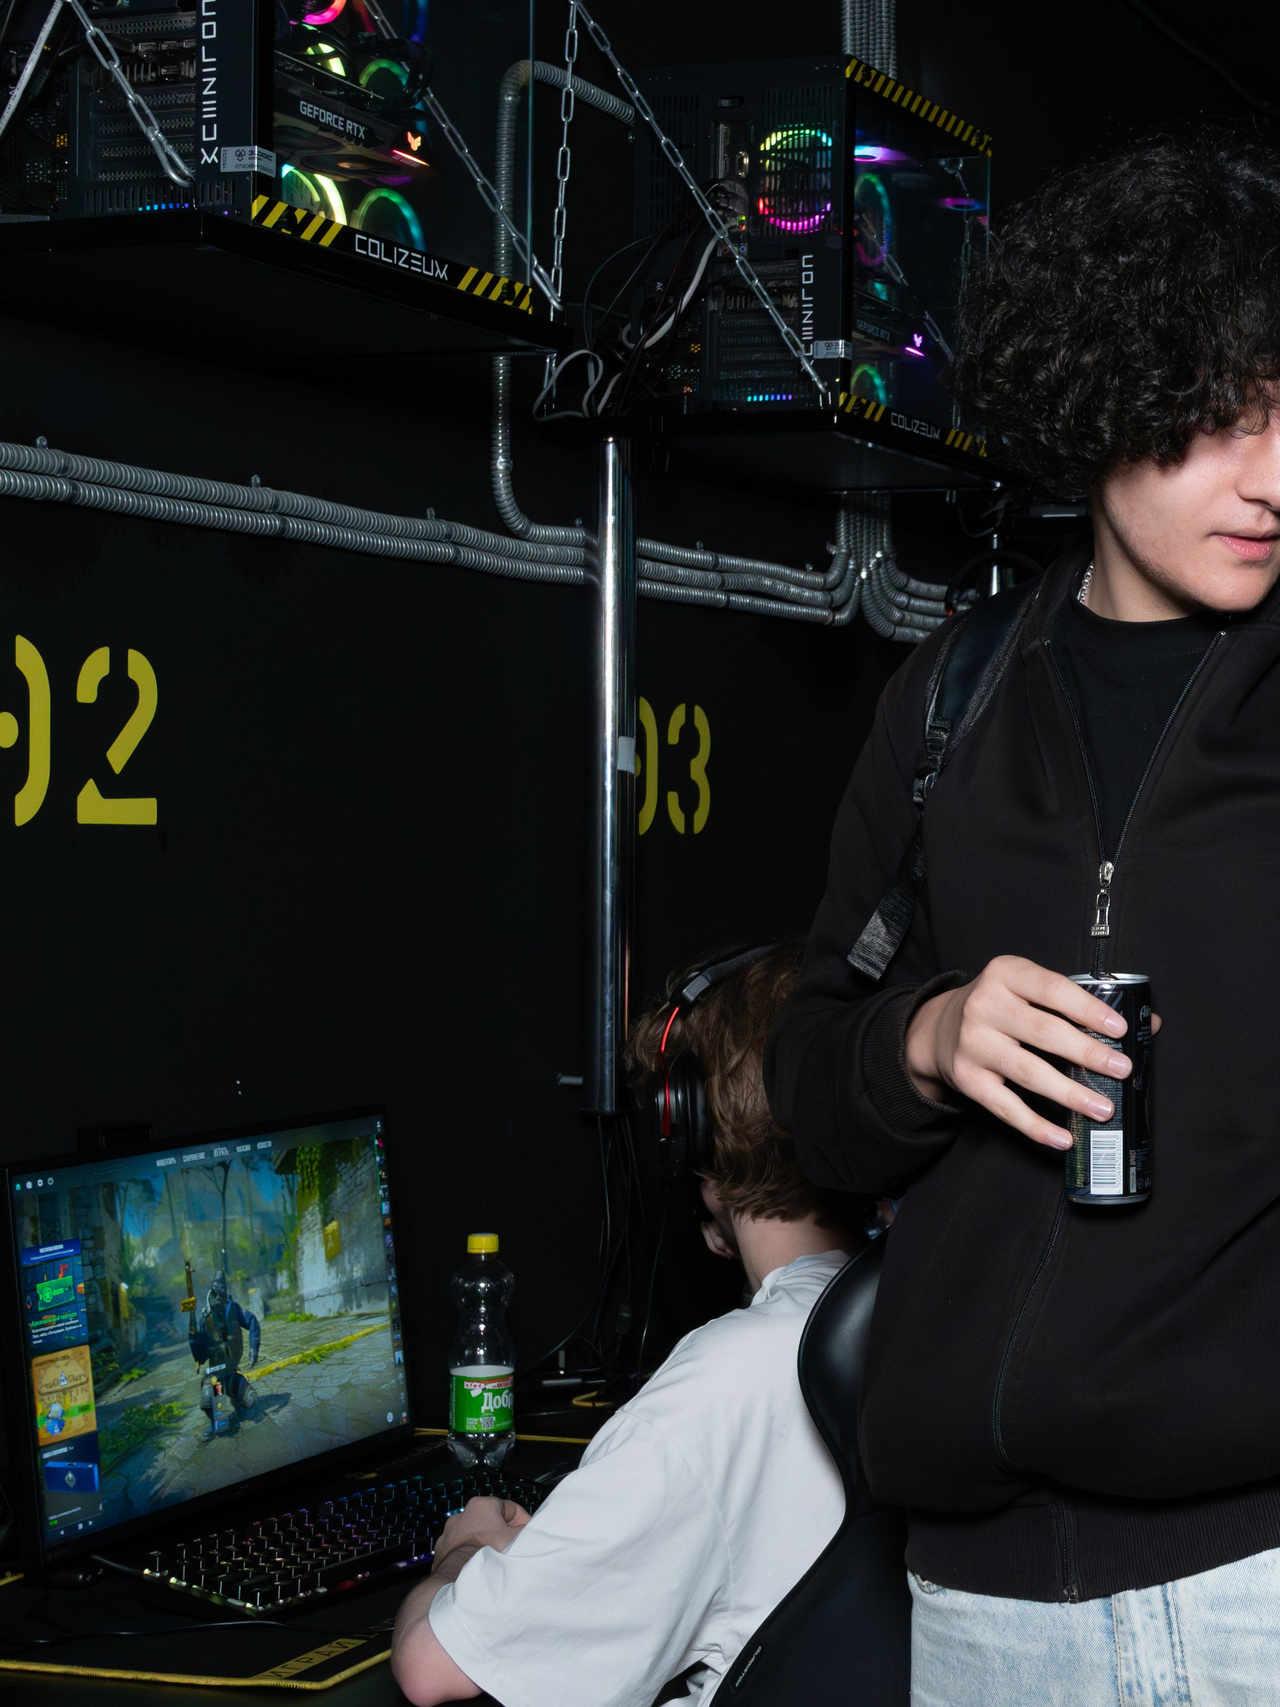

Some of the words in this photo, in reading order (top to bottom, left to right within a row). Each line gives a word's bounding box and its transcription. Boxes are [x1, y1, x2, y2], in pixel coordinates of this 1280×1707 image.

[300, 100, 345, 131] GEFORCE
[345, 119, 367, 140] RTX
[355, 233, 449, 281] COLIZEUM
[890, 411, 941, 441] COLIZEUM
